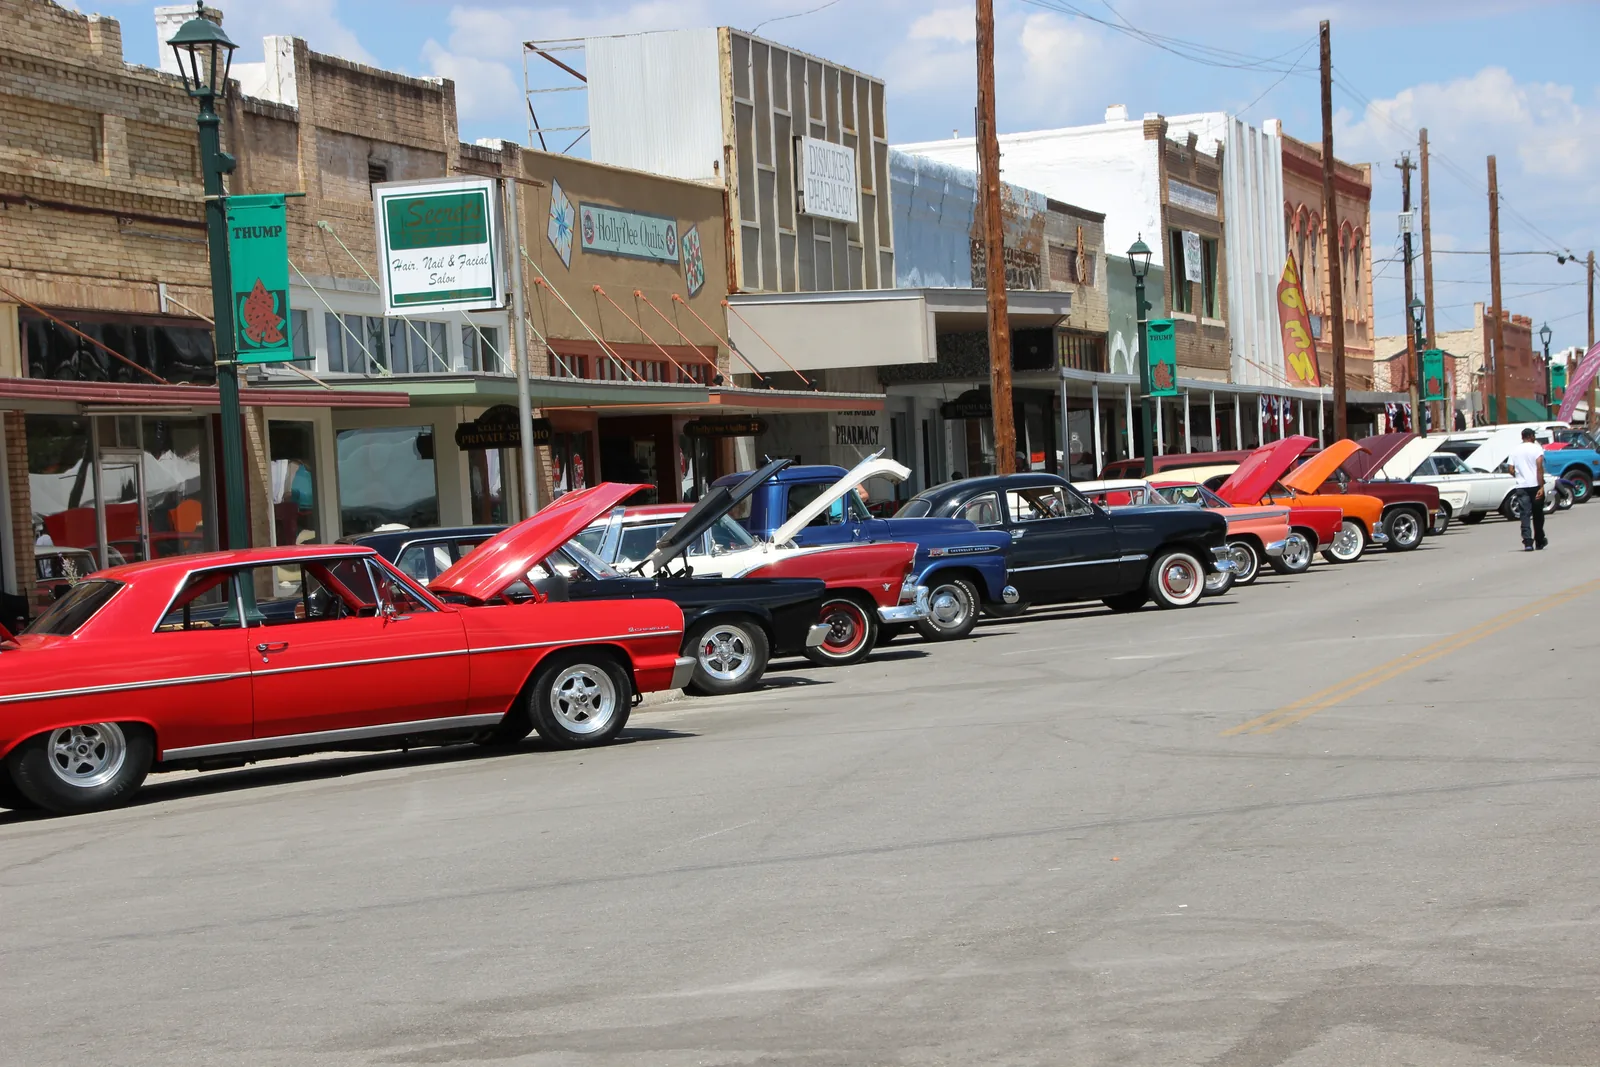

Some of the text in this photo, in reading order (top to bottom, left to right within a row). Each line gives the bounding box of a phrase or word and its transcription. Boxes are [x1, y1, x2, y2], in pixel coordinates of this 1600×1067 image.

[808, 178, 853, 216] PHARMACY
[406, 199, 482, 227] Secrets
[232, 225, 283, 240] THUMP
[640, 220, 665, 257] Quilts
[422, 256, 444, 270] Nail
[448, 254, 455, 268] &
[457, 252, 488, 269] Facial
[428, 272, 456, 286] Salon
[1150, 334, 1173, 342] THUMP
[462, 432, 506, 444] PRIVATE
[835, 424, 880, 446] PHARMACY
